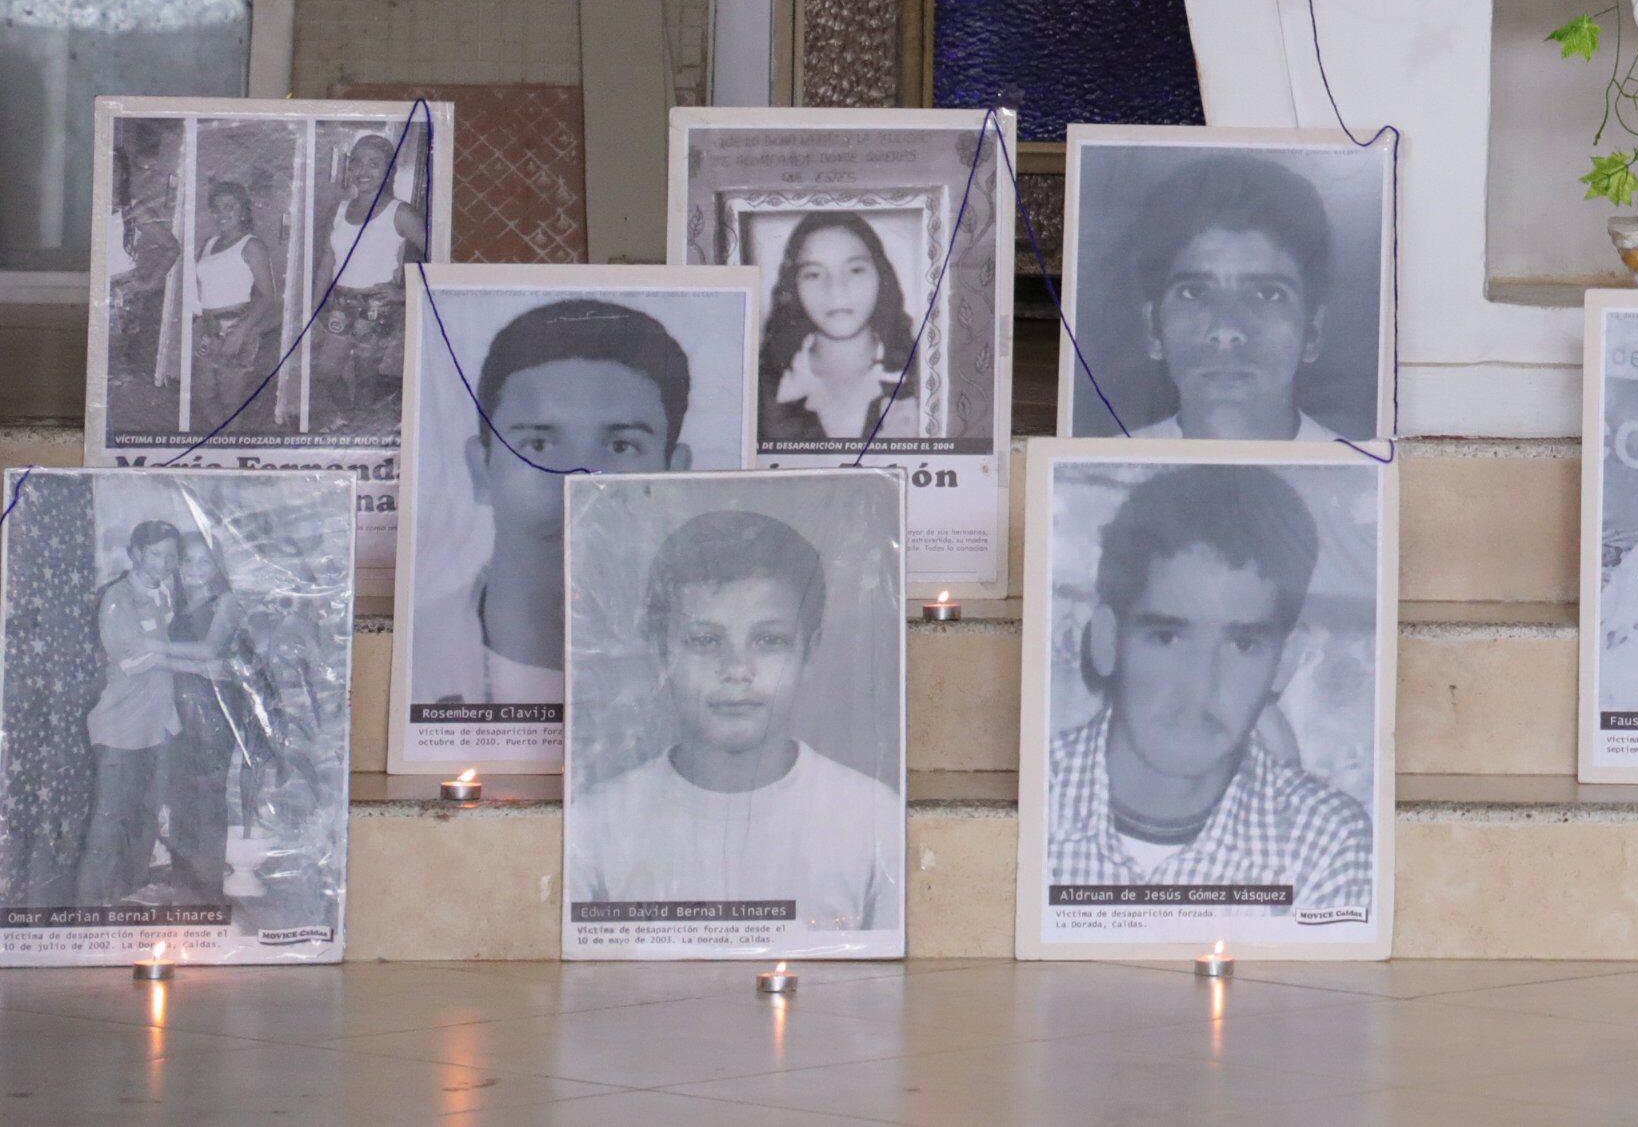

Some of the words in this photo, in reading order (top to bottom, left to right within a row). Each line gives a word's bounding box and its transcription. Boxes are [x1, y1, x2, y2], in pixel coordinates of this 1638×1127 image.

[422, 709, 492, 719] Rosemberg
[500, 708, 555, 719] Clavijo
[1060, 889, 1113, 900] Aldruan
[1120, 889, 1136, 900] de
[1144, 890, 1180, 900] Jesús
[1188, 890, 1225, 900] Gómez
[1233, 891, 1285, 900] Vásquez
[8, 912, 41, 922] Omar
[50, 912, 99, 921] Adrian
[108, 909, 155, 921] Bernal
[166, 911, 223, 920] Linares
[581, 907, 619, 917] Edwin
[628, 906, 668, 916] David
[676, 905, 722, 916] Bernal
[732, 907, 786, 915] Linares
